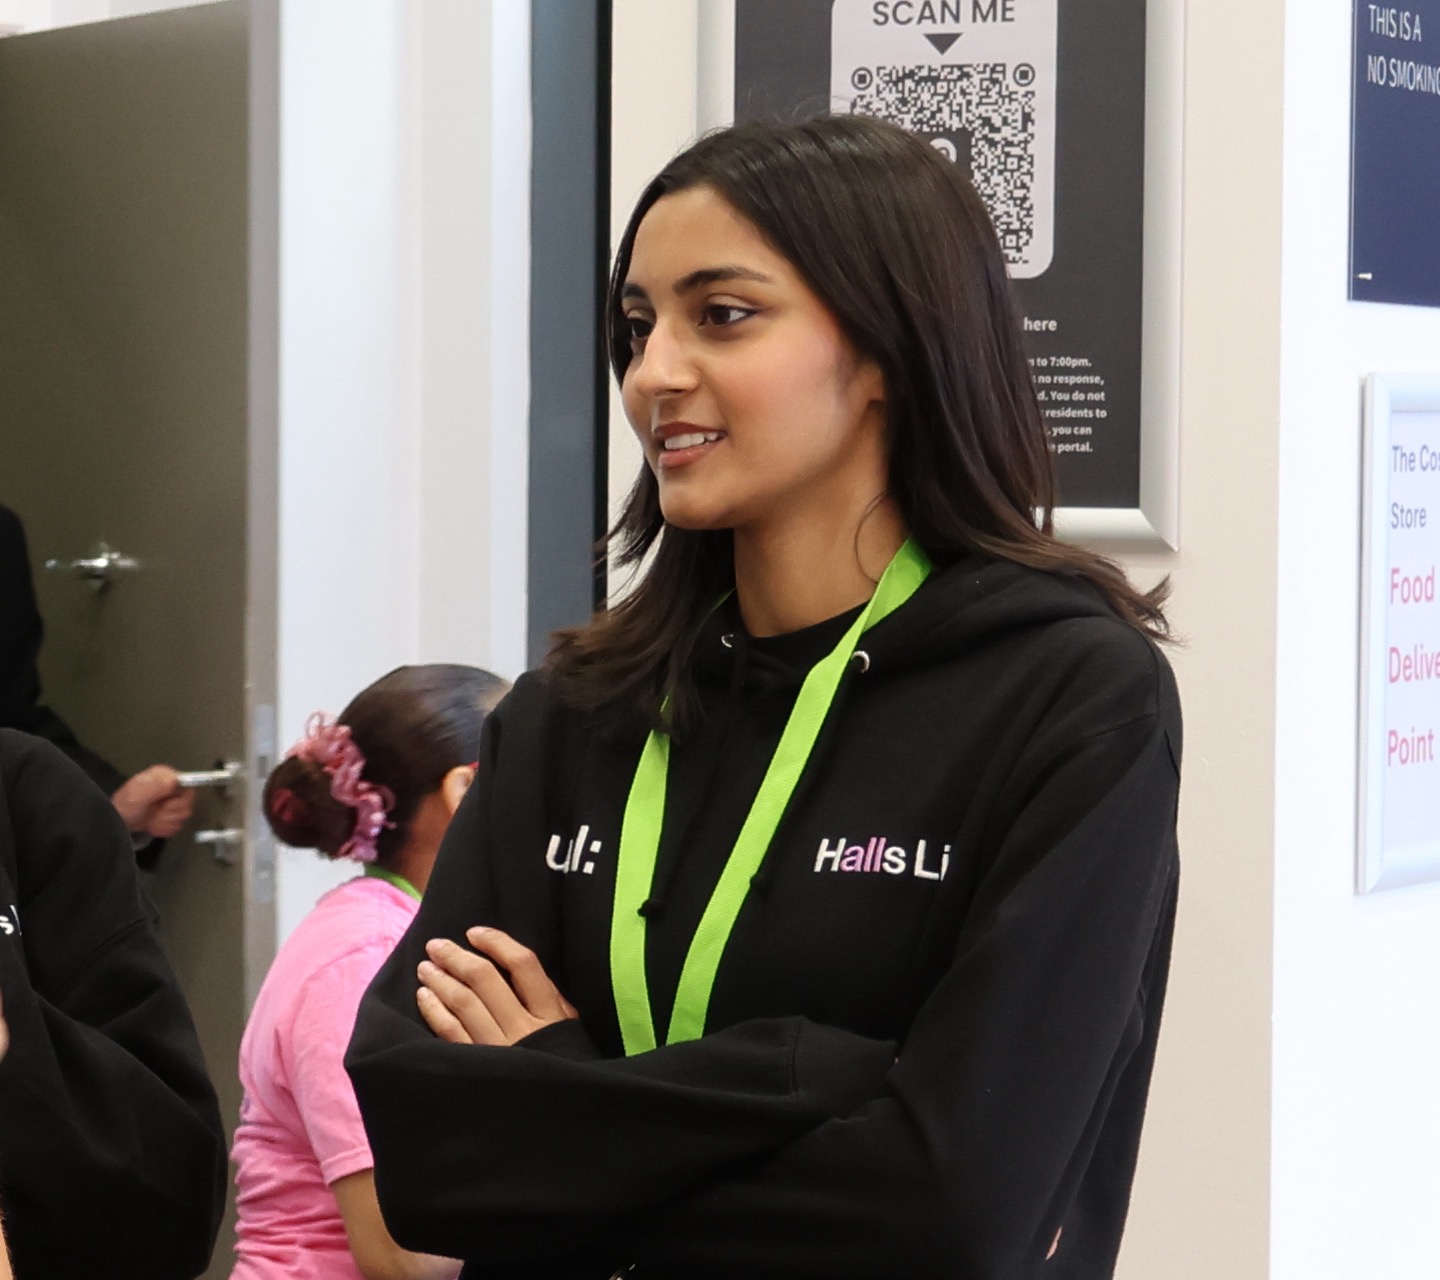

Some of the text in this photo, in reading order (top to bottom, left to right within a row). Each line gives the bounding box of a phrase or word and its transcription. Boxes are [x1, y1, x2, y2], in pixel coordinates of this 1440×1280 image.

[1368, 4, 1422, 42] THIS IS A
[1367, 55, 1386, 86] NO
[1023, 317, 1058, 332] here
[1036, 356, 1092, 368] to 7:00pm.
[1038, 375, 1105, 386] no response,
[1049, 391, 1070, 401] You
[1071, 390, 1086, 401] do
[1086, 391, 1105, 401] not
[1045, 407, 1107, 418] residents to
[1051, 426, 1092, 437] you can
[1057, 441, 1093, 454] portal.
[1392, 445, 1416, 472] The
[1391, 502, 1427, 529] Store
[1390, 565, 1435, 605] Food
[1388, 726, 1434, 767] Point
[545, 824, 602, 875] ul:
[814, 836, 907, 875] Halls
